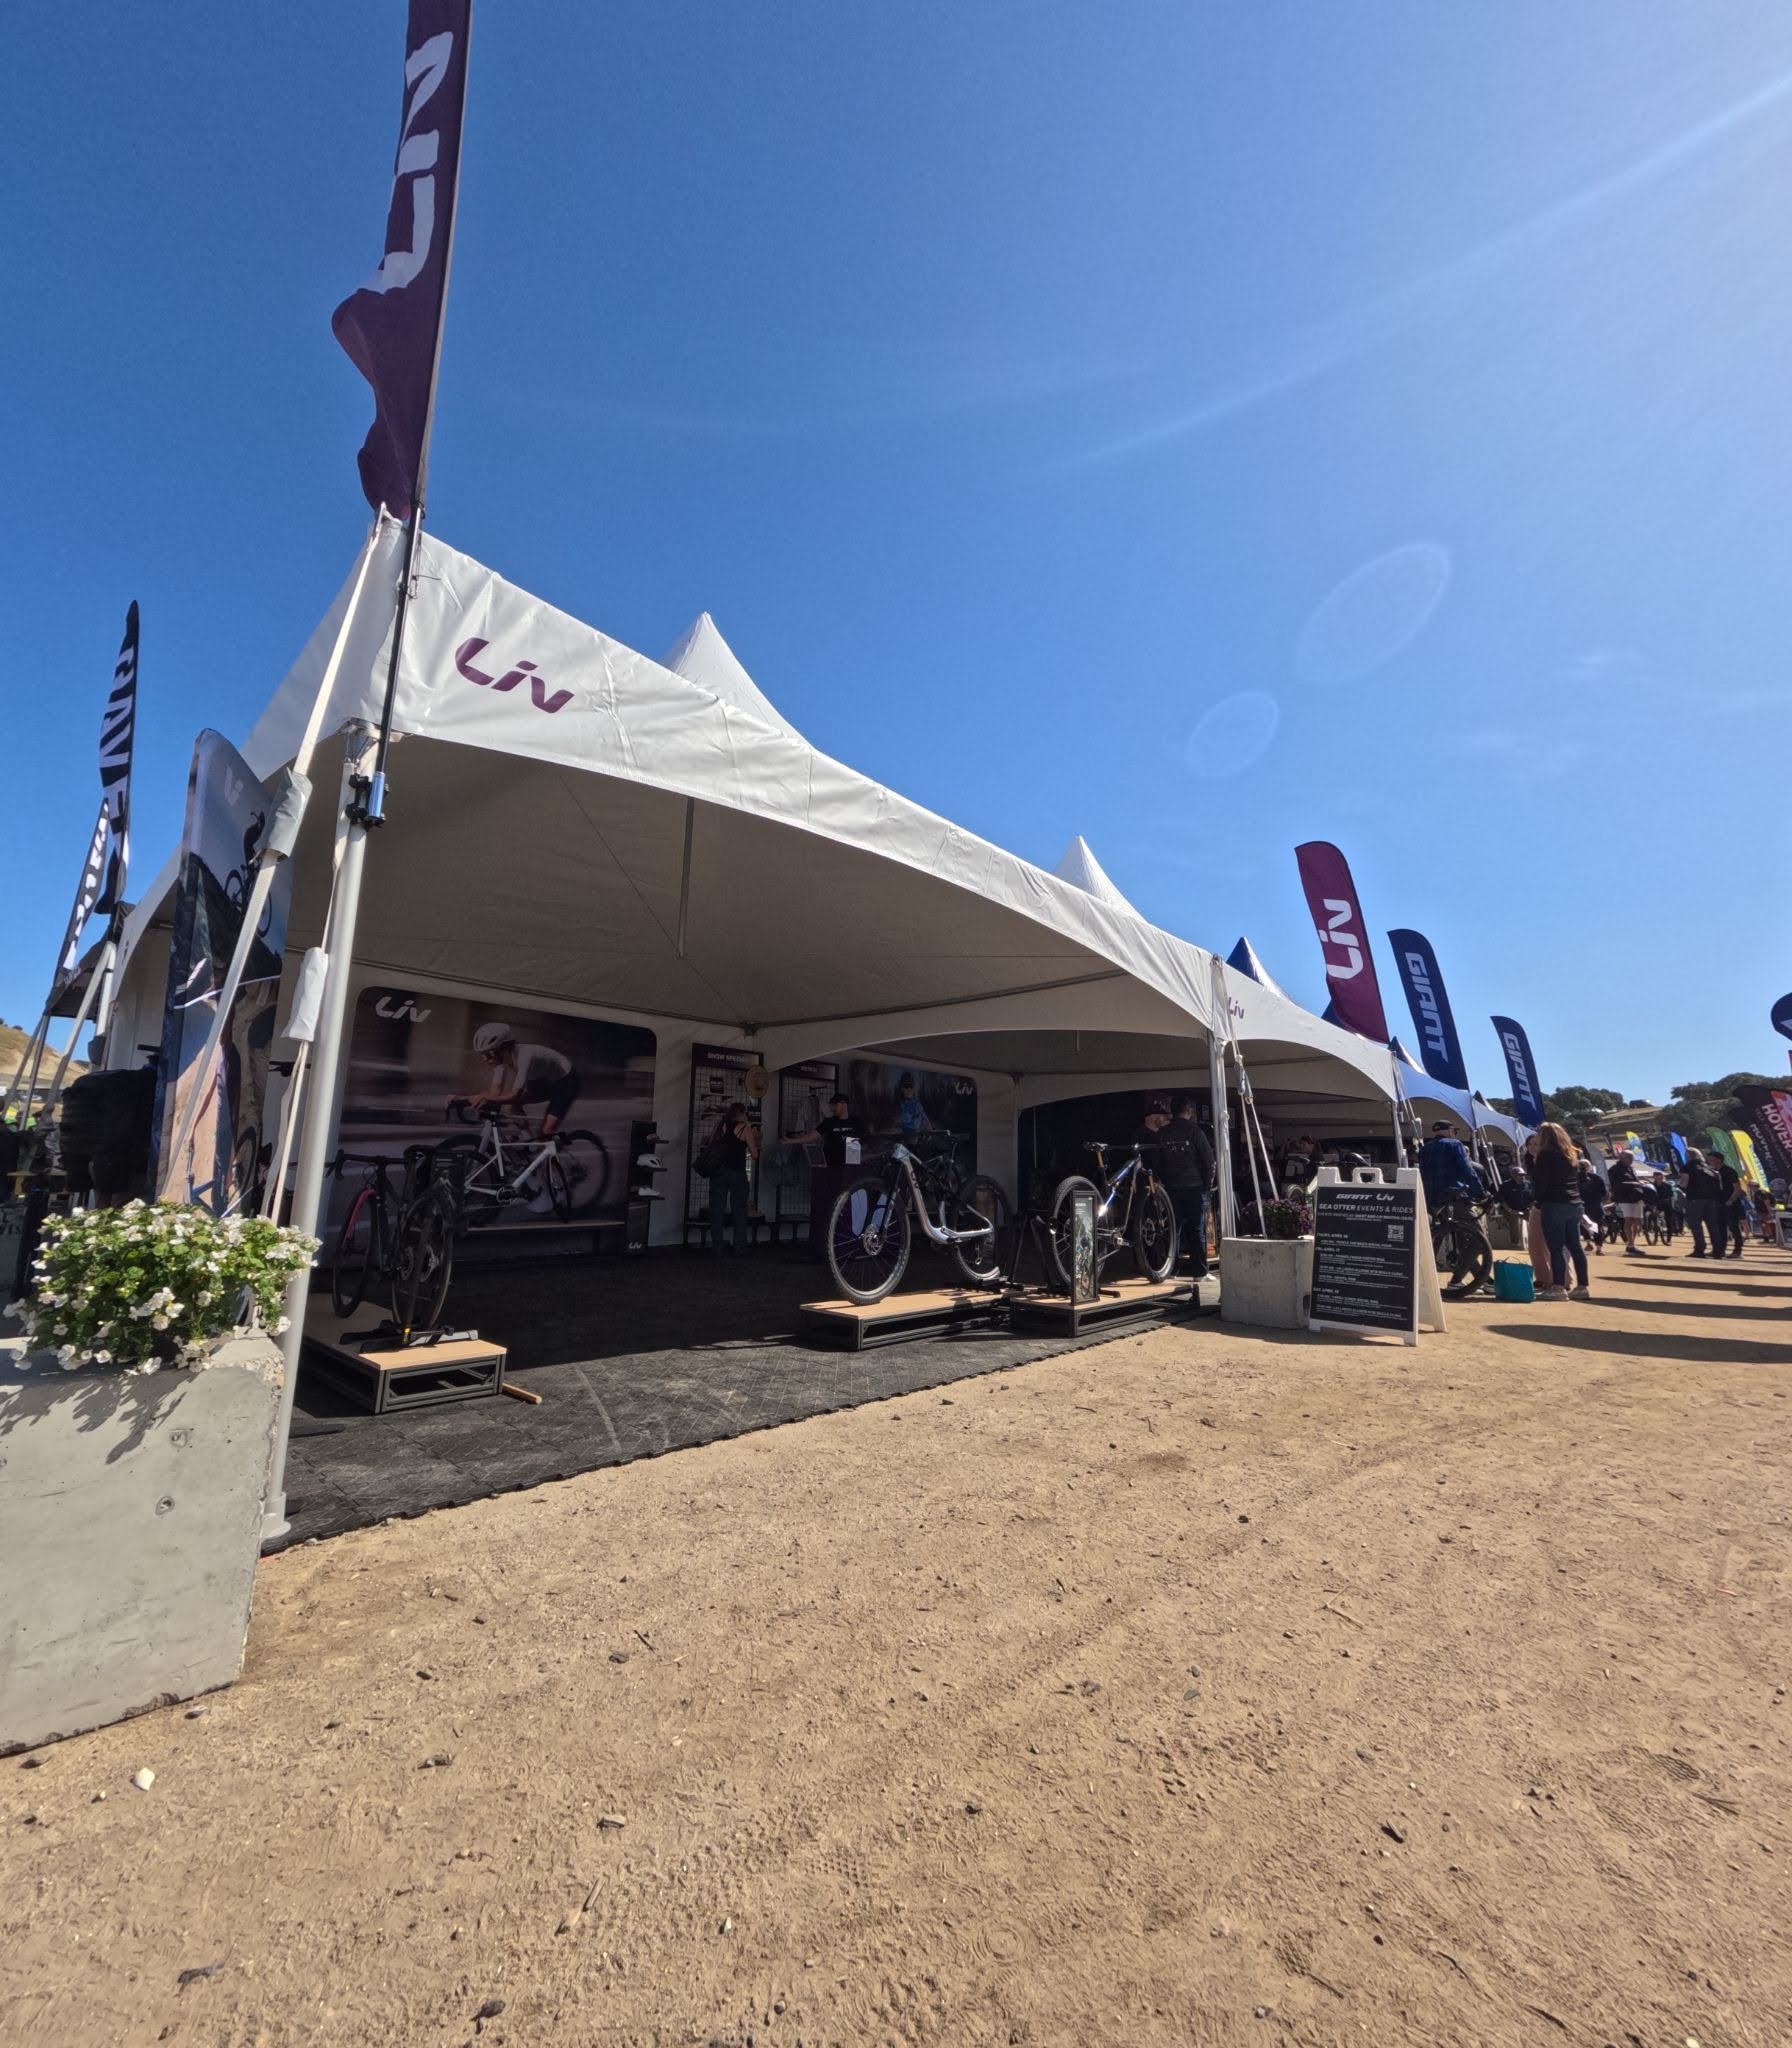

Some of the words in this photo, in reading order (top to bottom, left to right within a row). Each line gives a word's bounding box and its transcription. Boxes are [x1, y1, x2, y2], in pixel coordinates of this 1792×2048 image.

[360, 31, 454, 295] Liv
[454, 636, 575, 714] Liv
[1318, 898, 1364, 980] Liv
[375, 996, 432, 1023] Liv
[1226, 996, 1245, 1019] Liv
[1404, 951, 1449, 1064] GIANT
[955, 1081, 973, 1095] Liv
[1502, 1031, 1538, 1112] GIANT
[1356, 1205, 1384, 1213] EVENTS
[1391, 1206, 1414, 1214] RIDES
[1376, 1192, 1395, 1201] Liv
